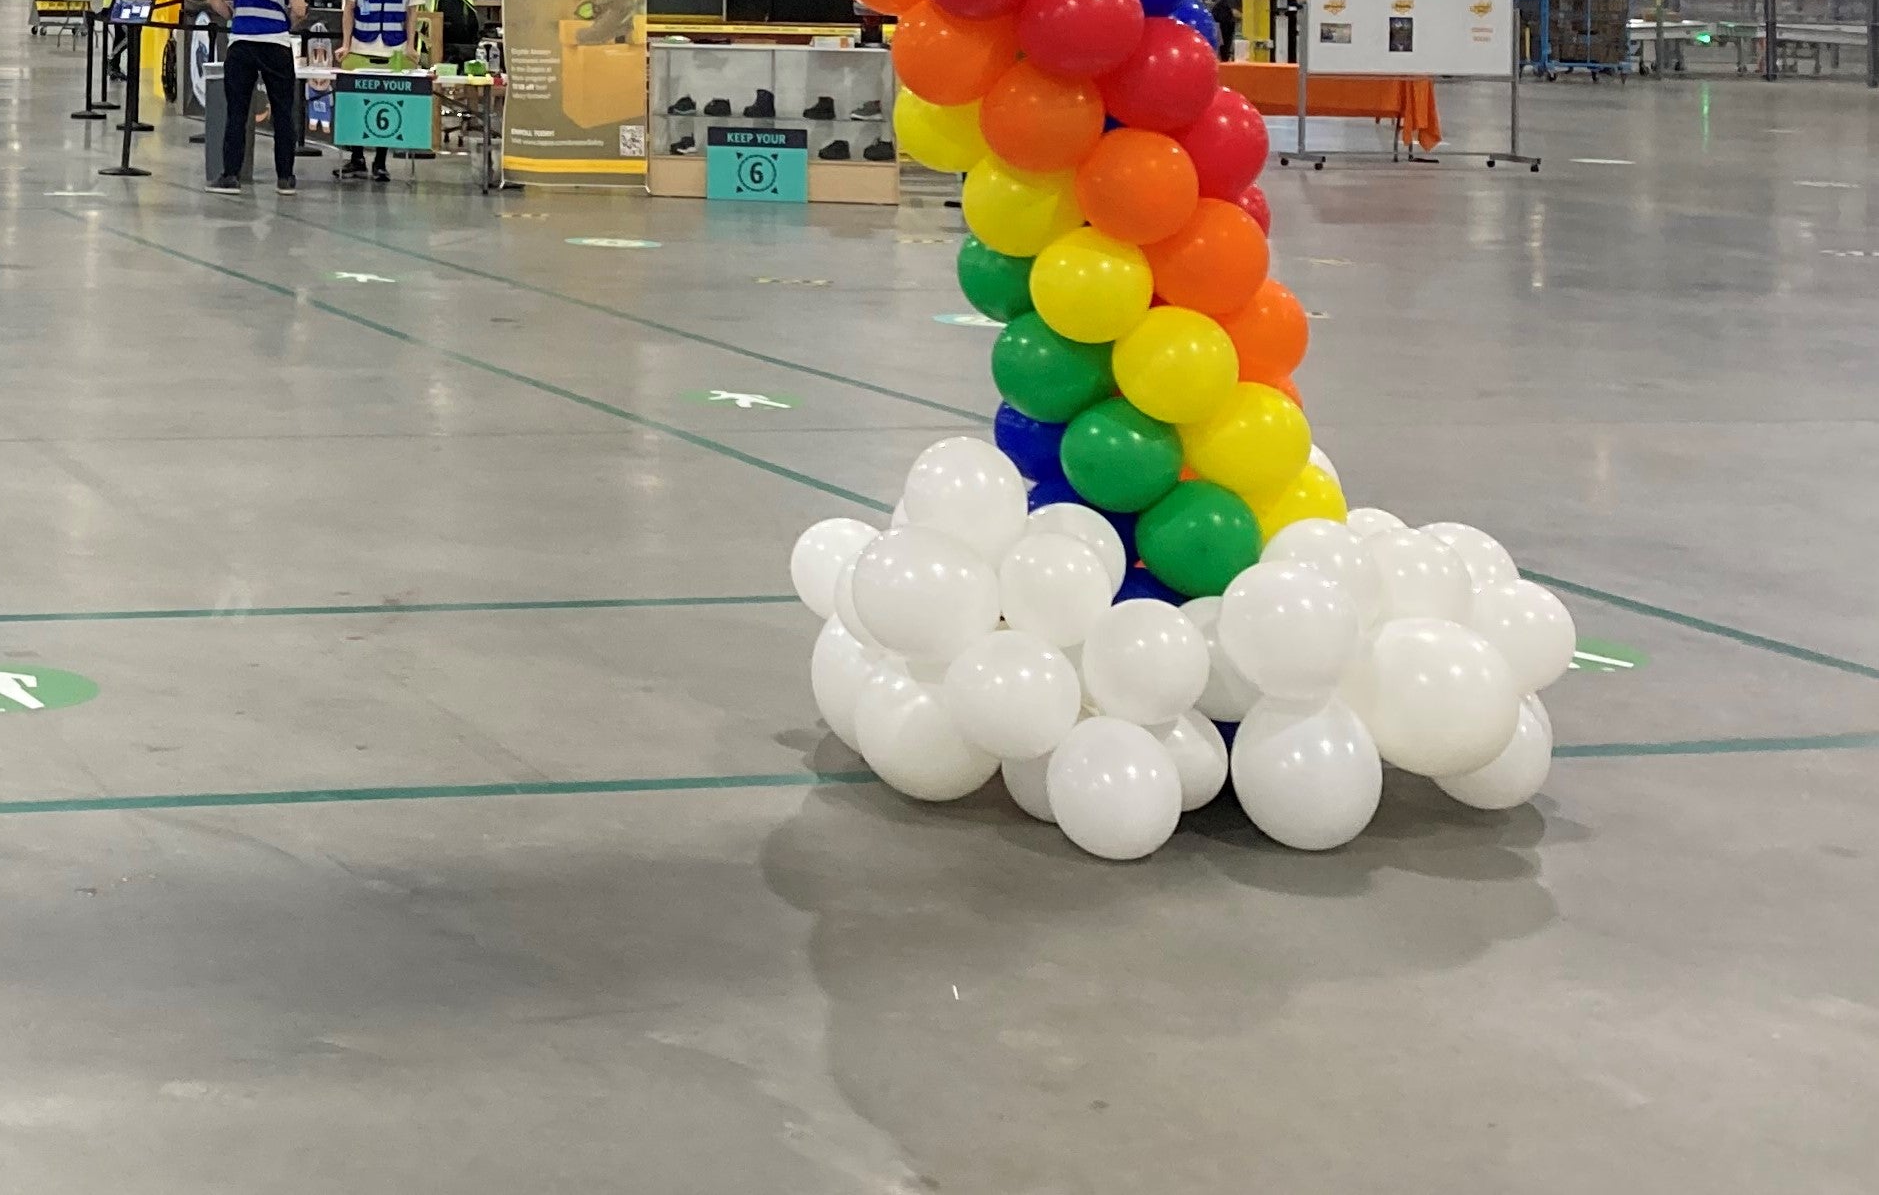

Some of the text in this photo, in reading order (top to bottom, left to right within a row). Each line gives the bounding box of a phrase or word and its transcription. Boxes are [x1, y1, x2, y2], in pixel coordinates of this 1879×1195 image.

[354, 78, 412, 91] KEEP YOUR
[376, 108, 390, 131] 6
[726, 132, 786, 145] KEEP YOUR
[749, 162, 764, 184] 6
